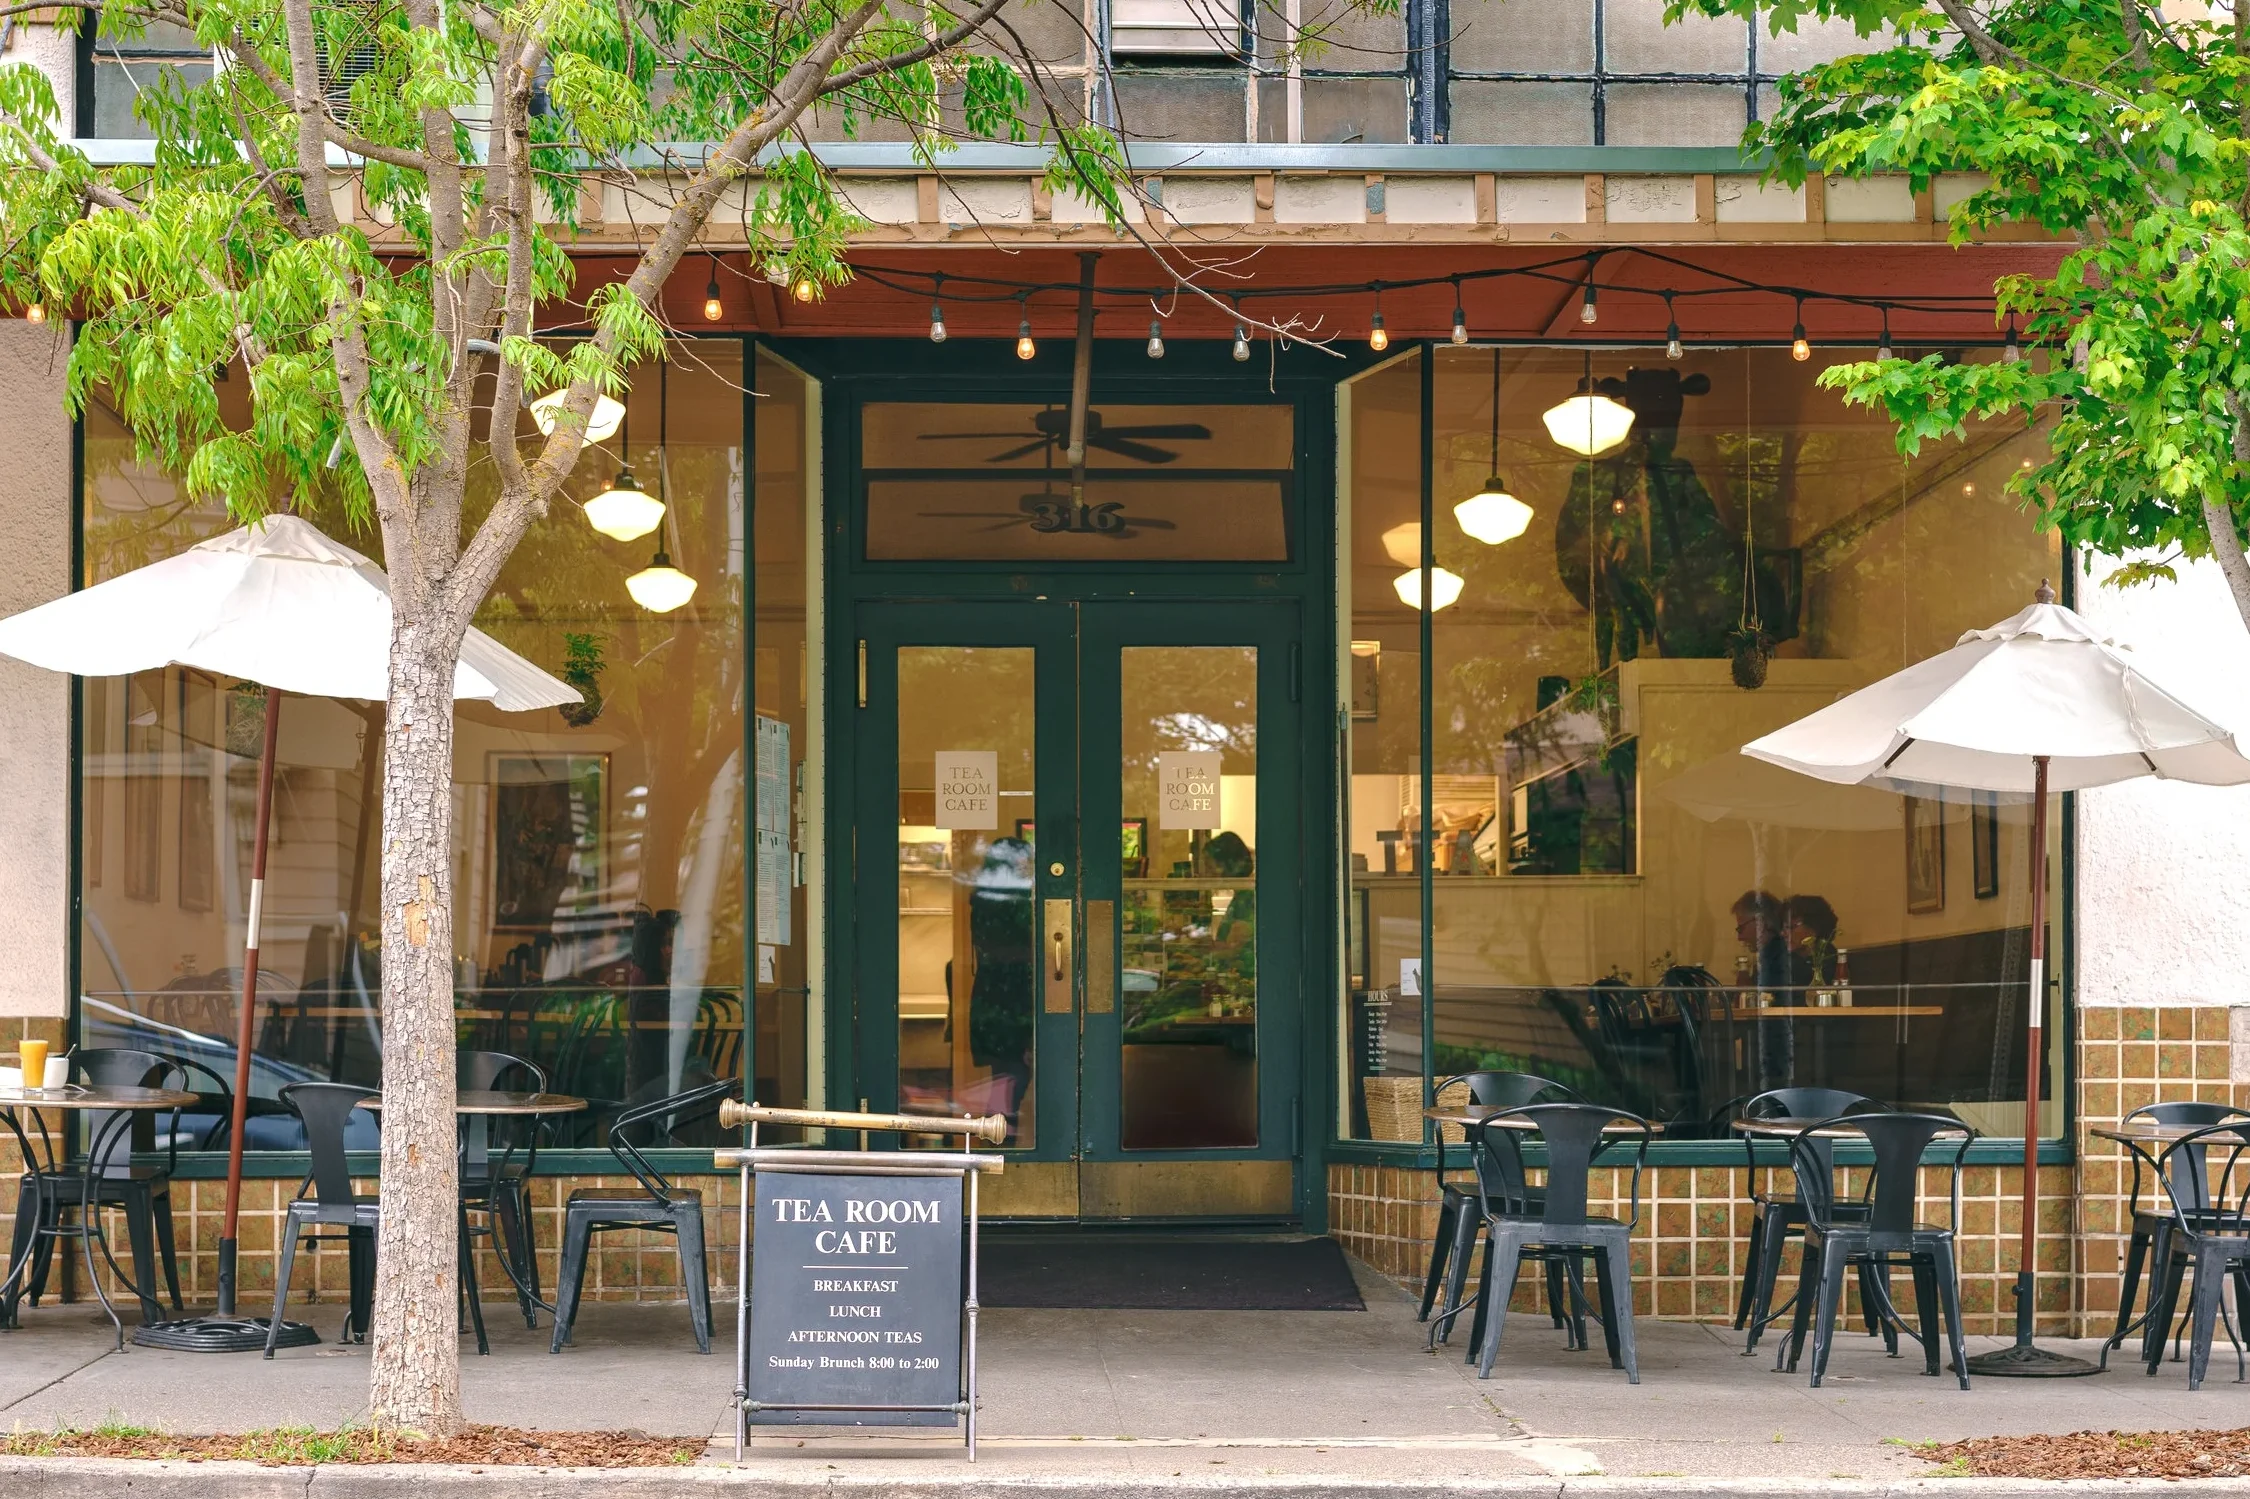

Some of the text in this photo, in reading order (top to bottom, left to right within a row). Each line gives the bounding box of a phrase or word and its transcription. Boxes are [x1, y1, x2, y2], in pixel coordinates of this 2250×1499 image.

[1030, 502, 1125, 533] 316
[949, 766, 984, 780] TEA
[1172, 766, 1208, 780] TEA
[942, 782, 992, 796] ROOM
[1165, 782, 1216, 796] ROOM
[945, 798, 988, 812] CAFE
[1169, 798, 1212, 812] CAFE
[1367, 989, 1389, 1002] HOURS
[771, 1198, 942, 1224] TEA ROOM
[815, 1230, 897, 1254] CAFE
[813, 1279, 899, 1293] BREAKFAST
[829, 1305, 882, 1318] LUNCH
[787, 1330, 923, 1344] AFTERNOON TEAS
[768, 1355, 940, 1370] Sunday Brunch 8:00 to 2:00
